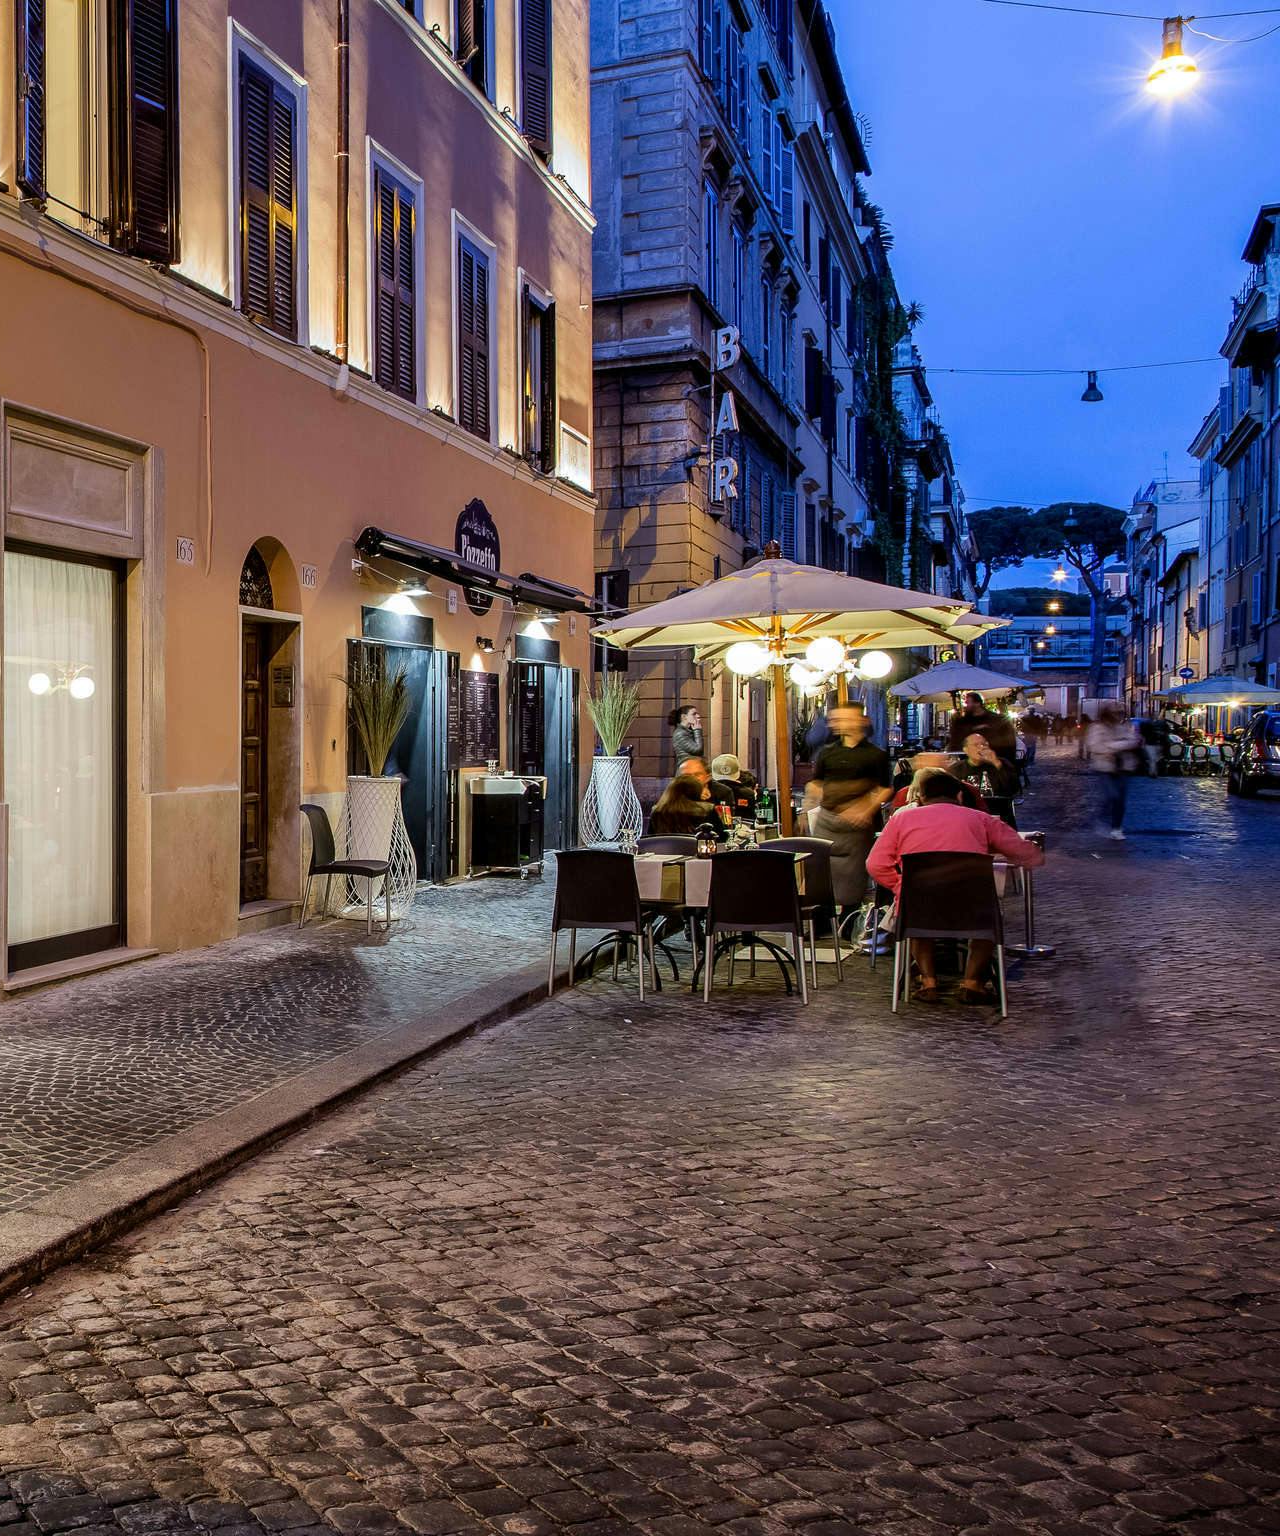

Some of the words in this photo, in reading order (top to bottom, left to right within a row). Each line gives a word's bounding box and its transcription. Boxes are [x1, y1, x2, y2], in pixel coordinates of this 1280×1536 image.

[713, 324, 741, 501] BAR
[176, 539, 194, 562] 165
[302, 566, 317, 586] 166
